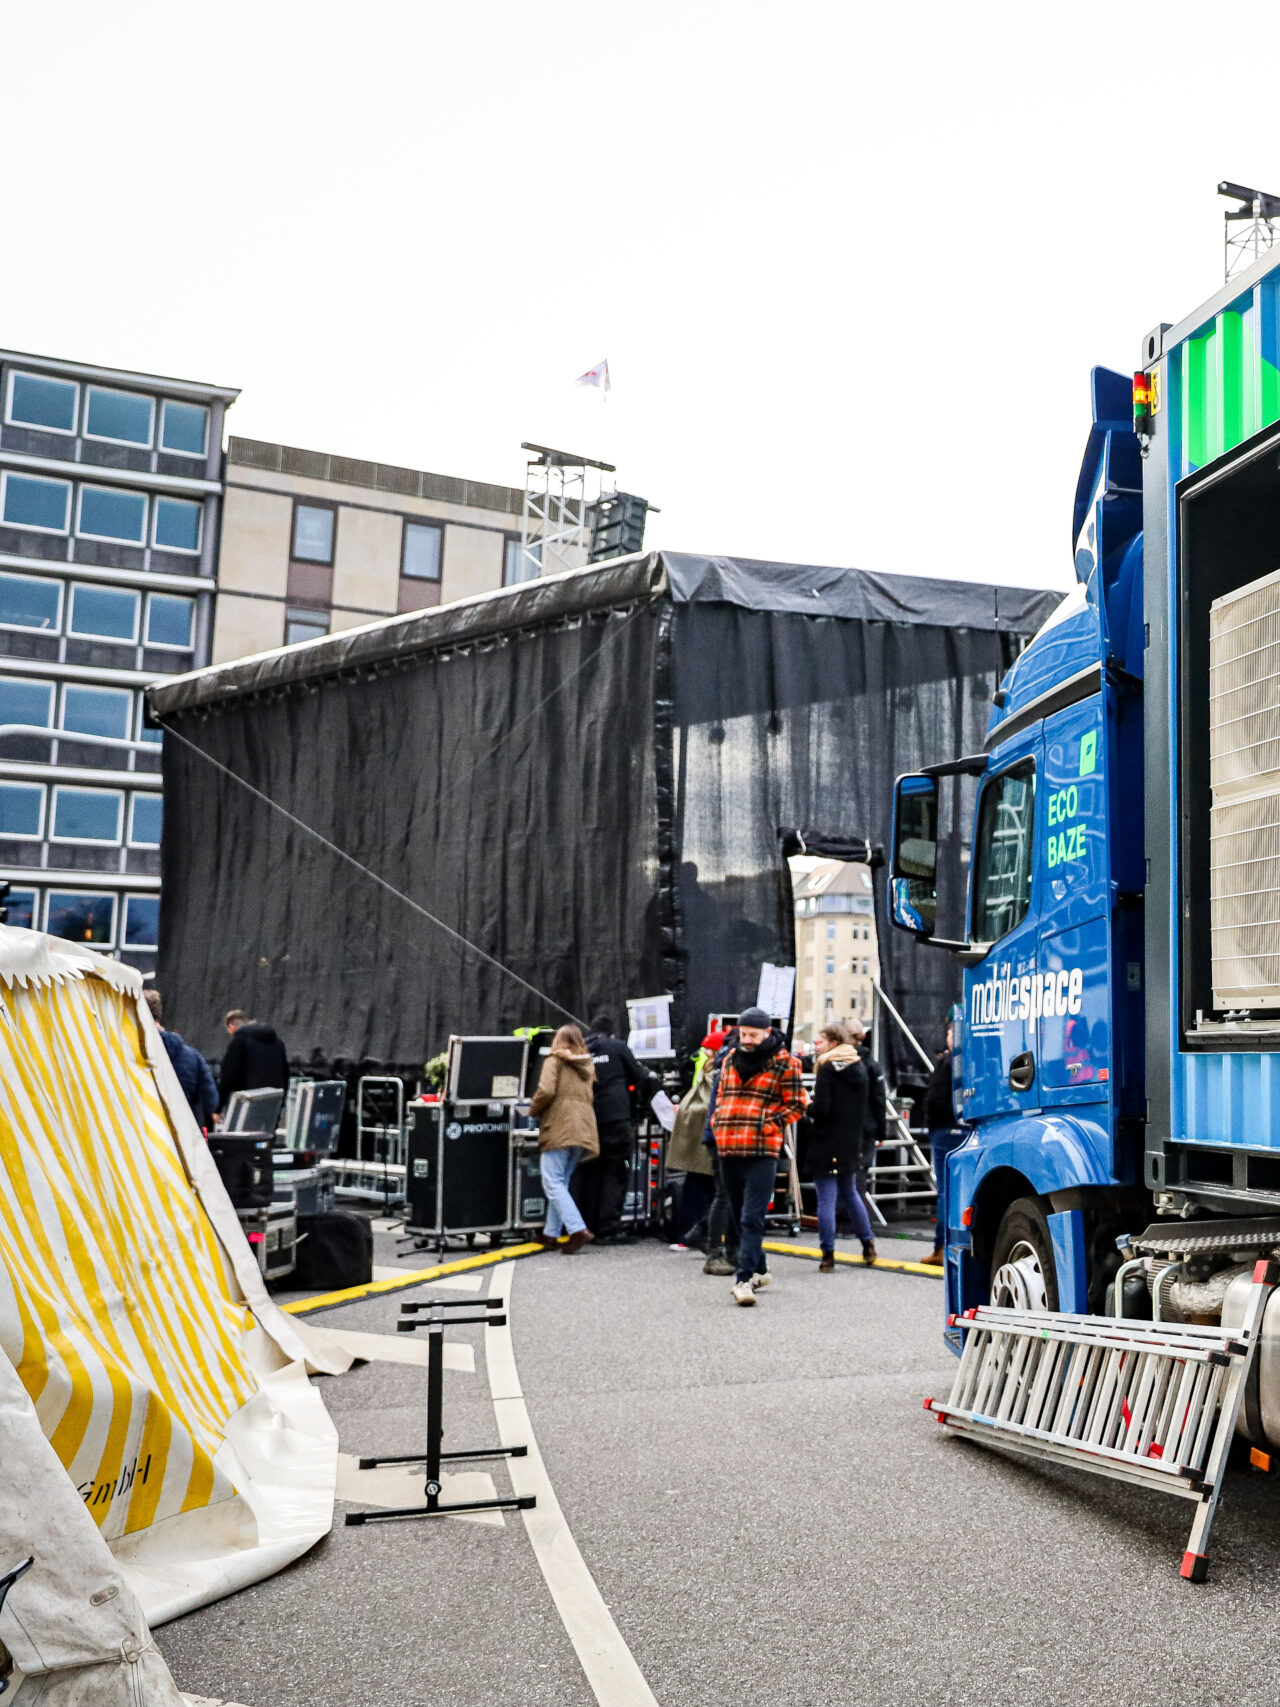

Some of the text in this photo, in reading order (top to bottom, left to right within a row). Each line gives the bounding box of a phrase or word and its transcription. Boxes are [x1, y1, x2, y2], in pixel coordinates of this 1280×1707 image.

[1048, 784, 1078, 827] ECO
[1047, 823, 1087, 869] BAZE
[971, 962, 1083, 1034] mobilespace
